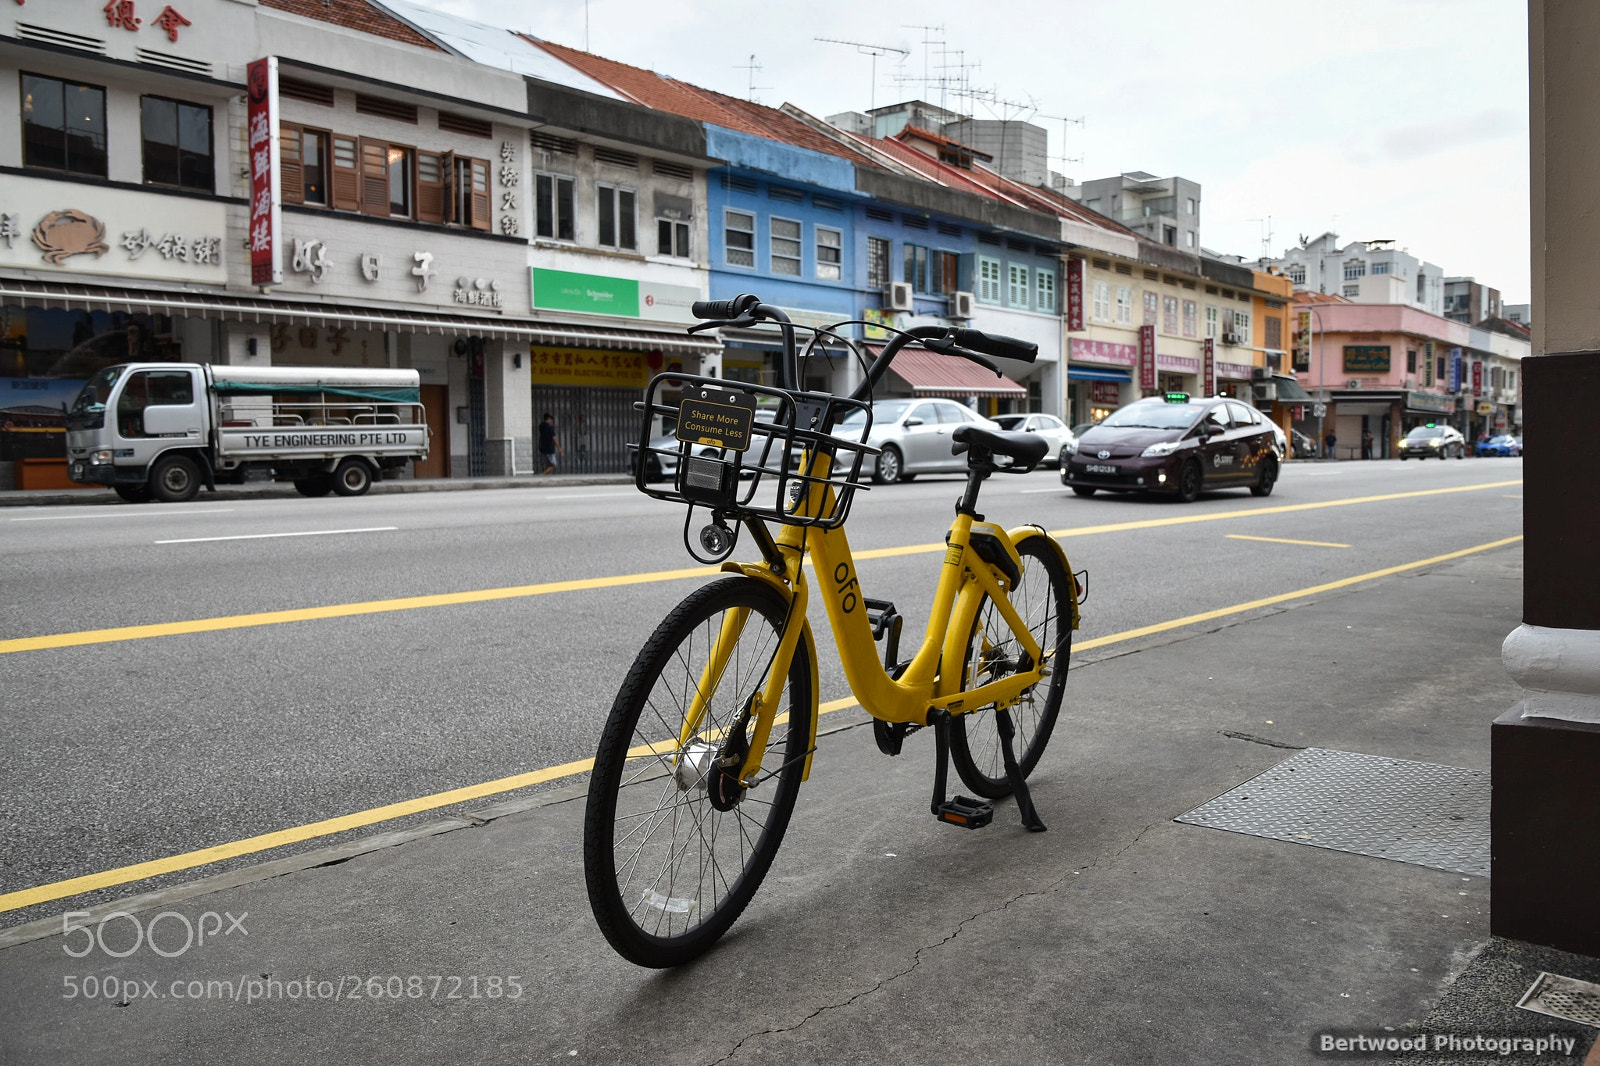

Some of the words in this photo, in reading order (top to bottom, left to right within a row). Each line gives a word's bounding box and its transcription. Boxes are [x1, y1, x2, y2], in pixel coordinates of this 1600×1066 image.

[292, 237, 438, 294] 好日子
[691, 410, 715, 422] Share
[716, 414, 739, 425] More
[685, 421, 723, 435] Consume
[725, 428, 743, 438] Less
[244, 436, 270, 448] TYE
[274, 433, 356, 447] ENGINEERING
[360, 433, 382, 445] PTE
[386, 432, 407, 444] LTD
[707, 438, 716, 446] ofo
[834, 562, 858, 614] ofo
